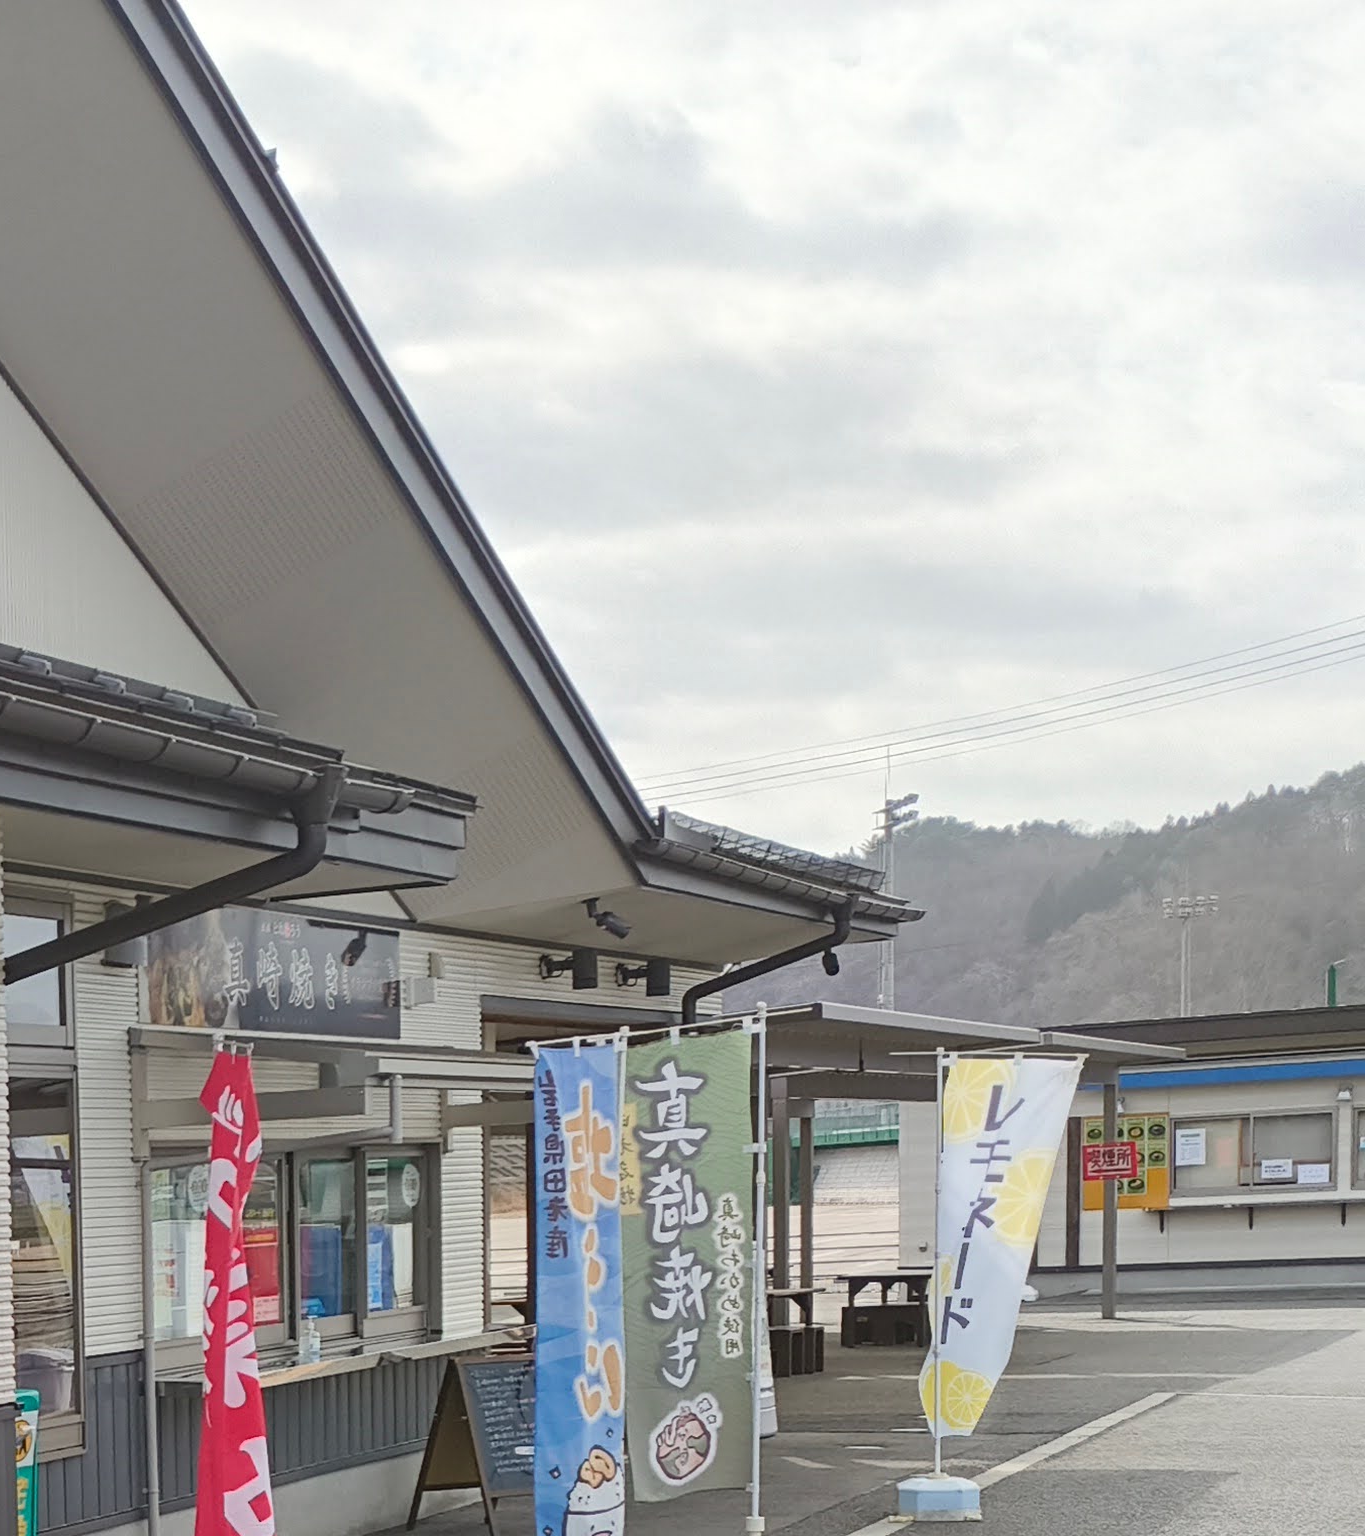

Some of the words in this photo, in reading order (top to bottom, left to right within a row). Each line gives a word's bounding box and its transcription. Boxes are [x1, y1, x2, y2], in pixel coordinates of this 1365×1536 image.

[223, 937, 340, 1010] 真崎焼き
[1088, 1148, 1131, 1168] 喫煙所
